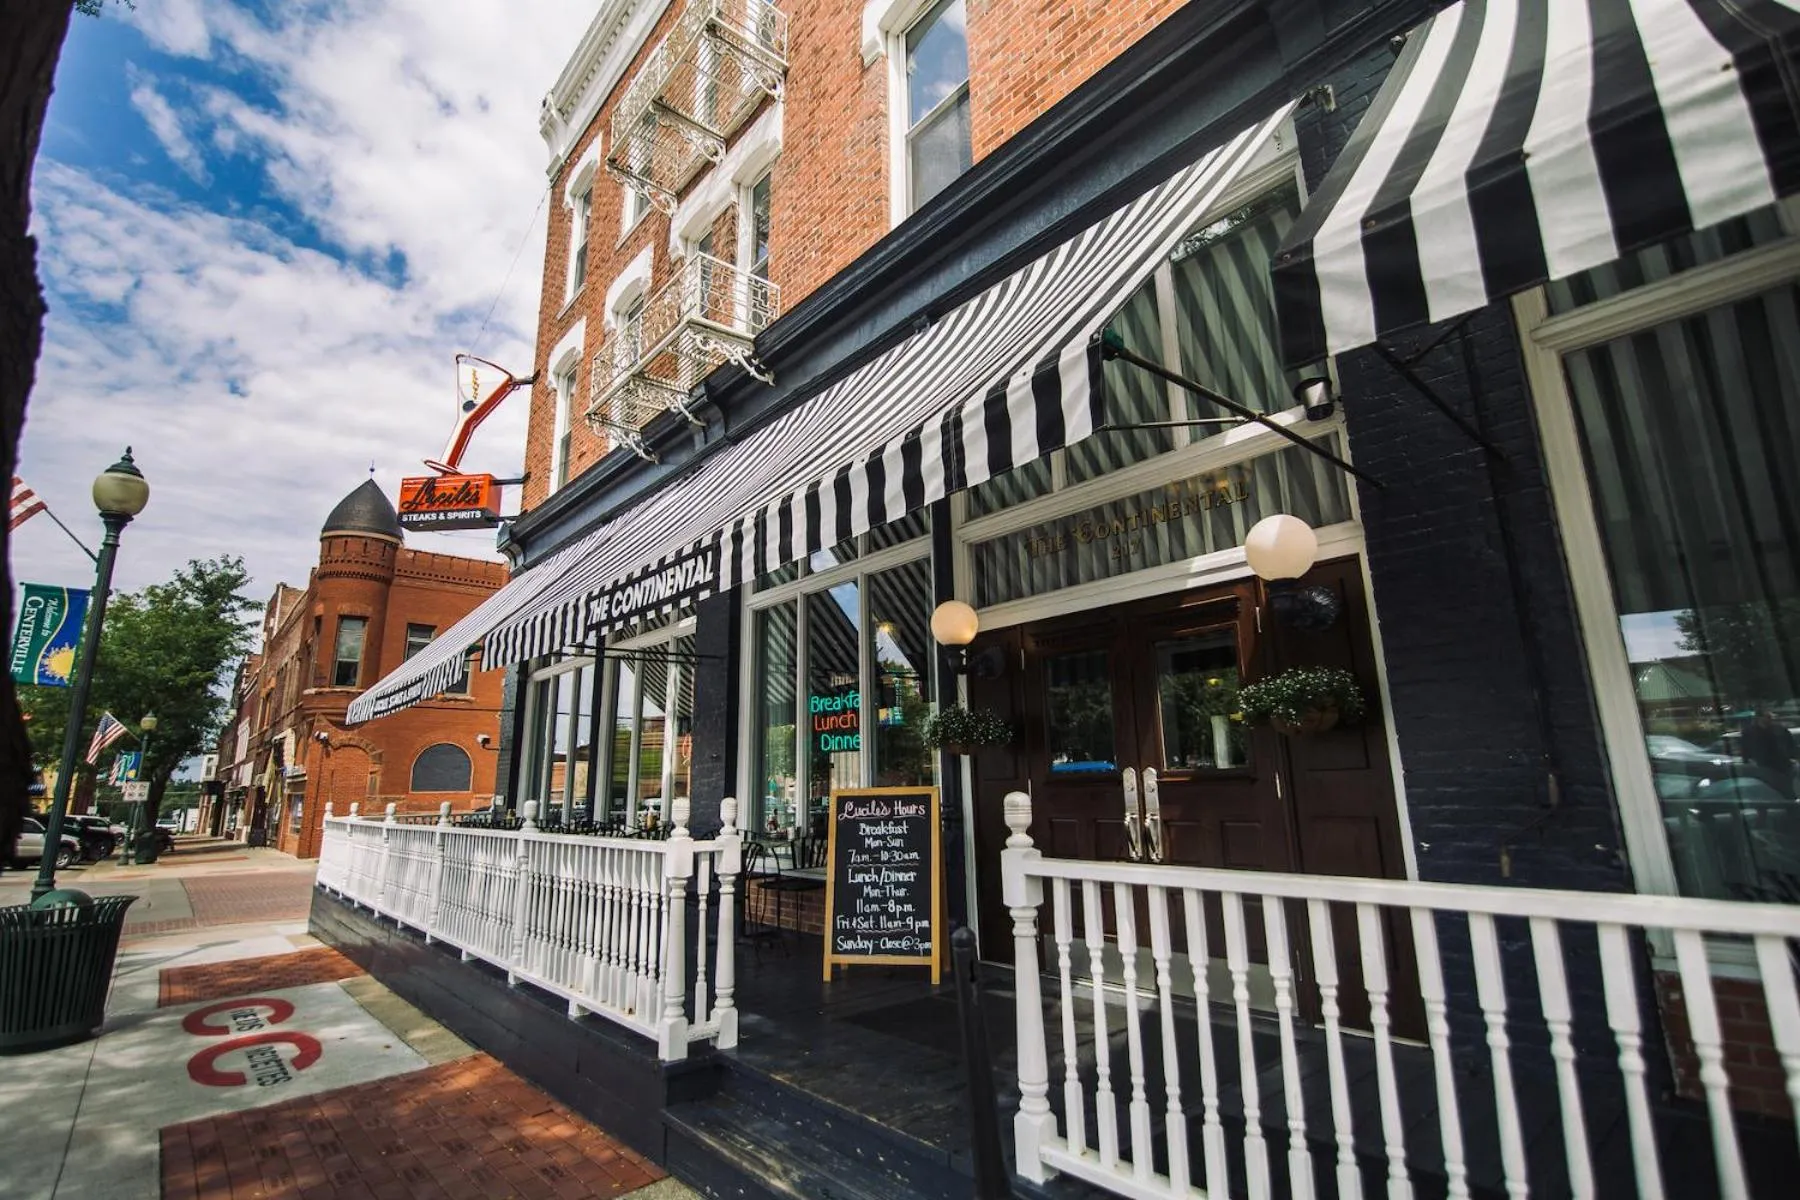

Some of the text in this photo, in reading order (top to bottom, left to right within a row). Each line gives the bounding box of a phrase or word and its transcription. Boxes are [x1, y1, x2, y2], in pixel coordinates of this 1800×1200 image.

[401, 510, 482, 522] STEAKS & SPIRITS
[1027, 483, 1249, 558] THE CONTINENTAL
[586, 550, 714, 626] THE CONTINENTAL
[10, 595, 45, 674] CENTERVILLE
[810, 690, 861, 713] Breakfa
[814, 710, 858, 731] Lunch
[821, 733, 862, 751] Dinne
[838, 800, 926, 820] Lucile's Hours
[858, 820, 910, 836] Breakfast
[865, 836, 905, 849] Mon-Sun
